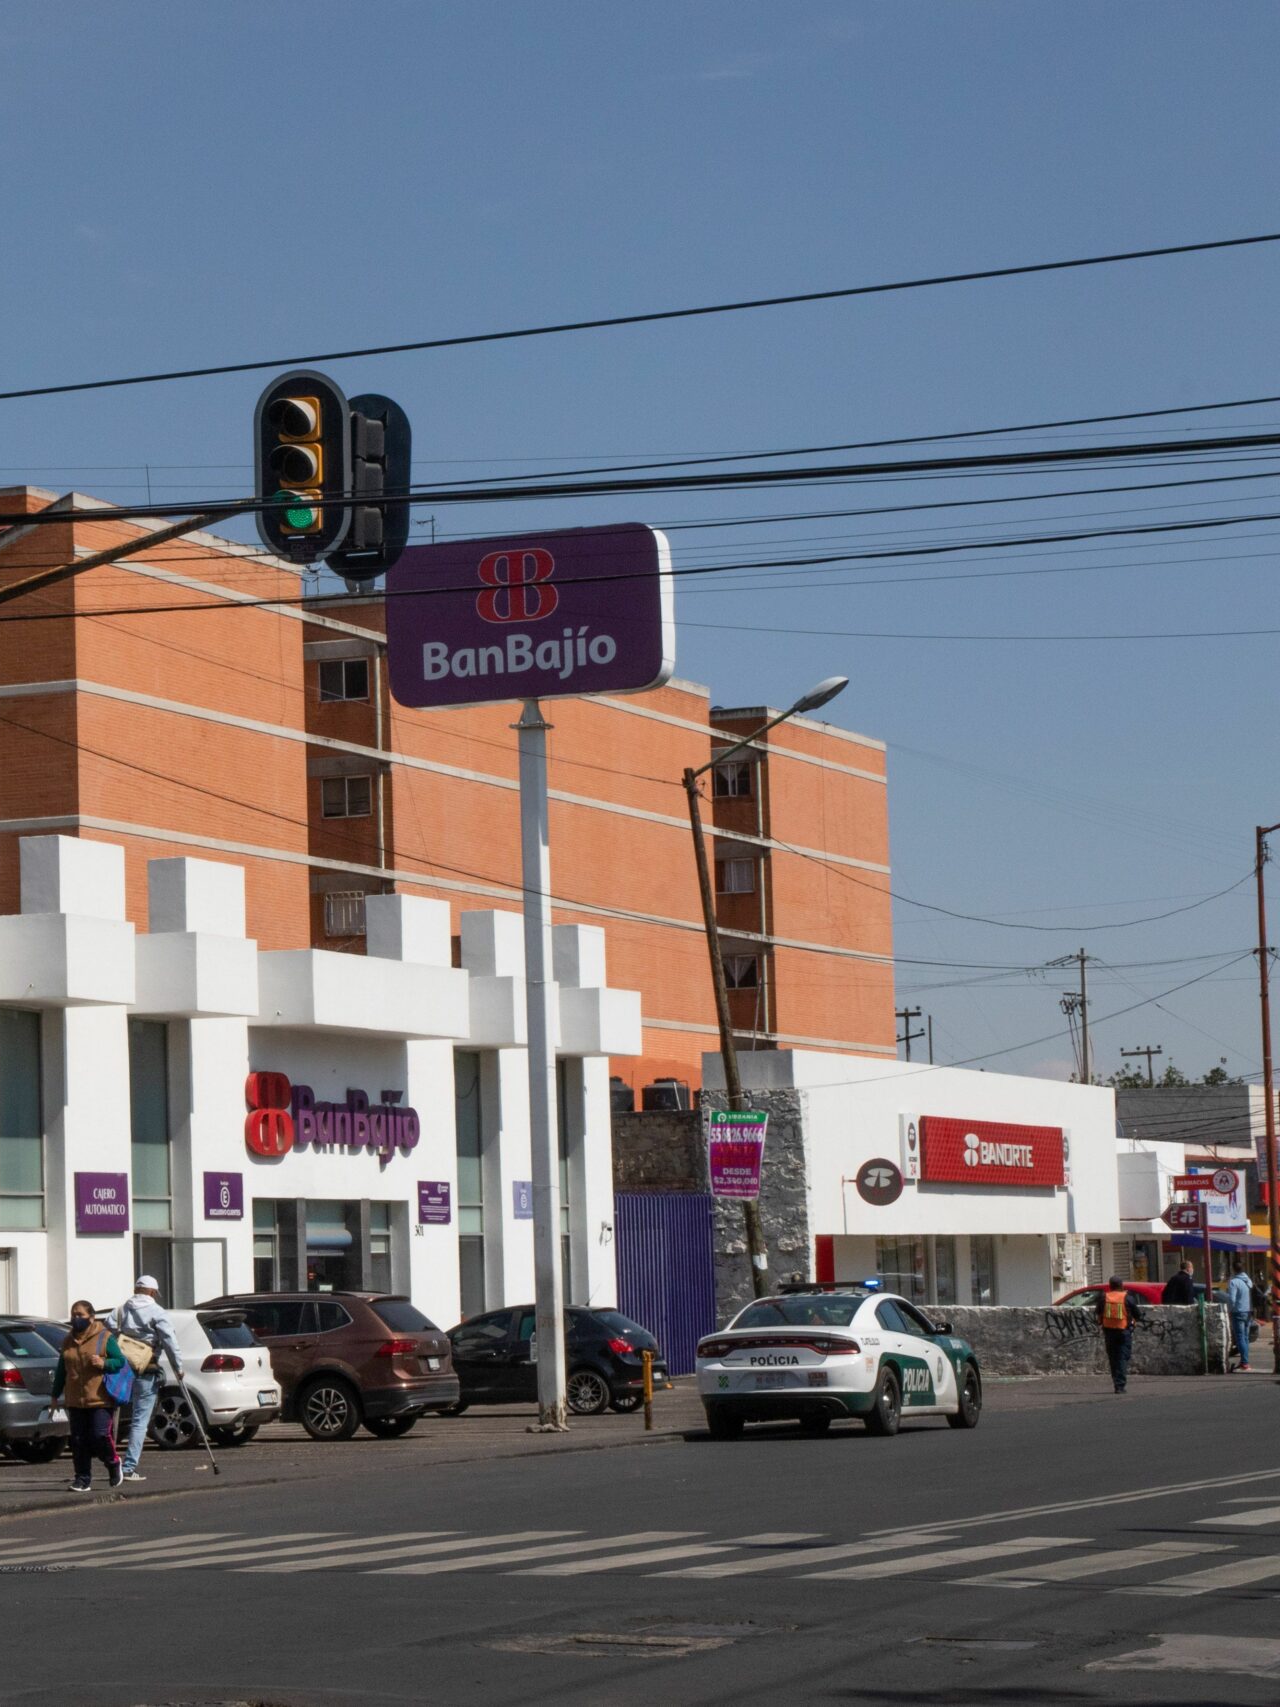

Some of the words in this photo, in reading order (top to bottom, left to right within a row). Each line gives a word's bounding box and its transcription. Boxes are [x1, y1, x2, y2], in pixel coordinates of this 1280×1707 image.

[423, 625, 617, 681] BanBajío
[980, 1141, 1034, 1168] BANORTE
[722, 1168, 753, 1176] DESDE
[1176, 1178, 1210, 1187] FARMACIAS
[93, 1187, 117, 1200] CAJERO
[84, 1203, 126, 1216] AUTOMATICO
